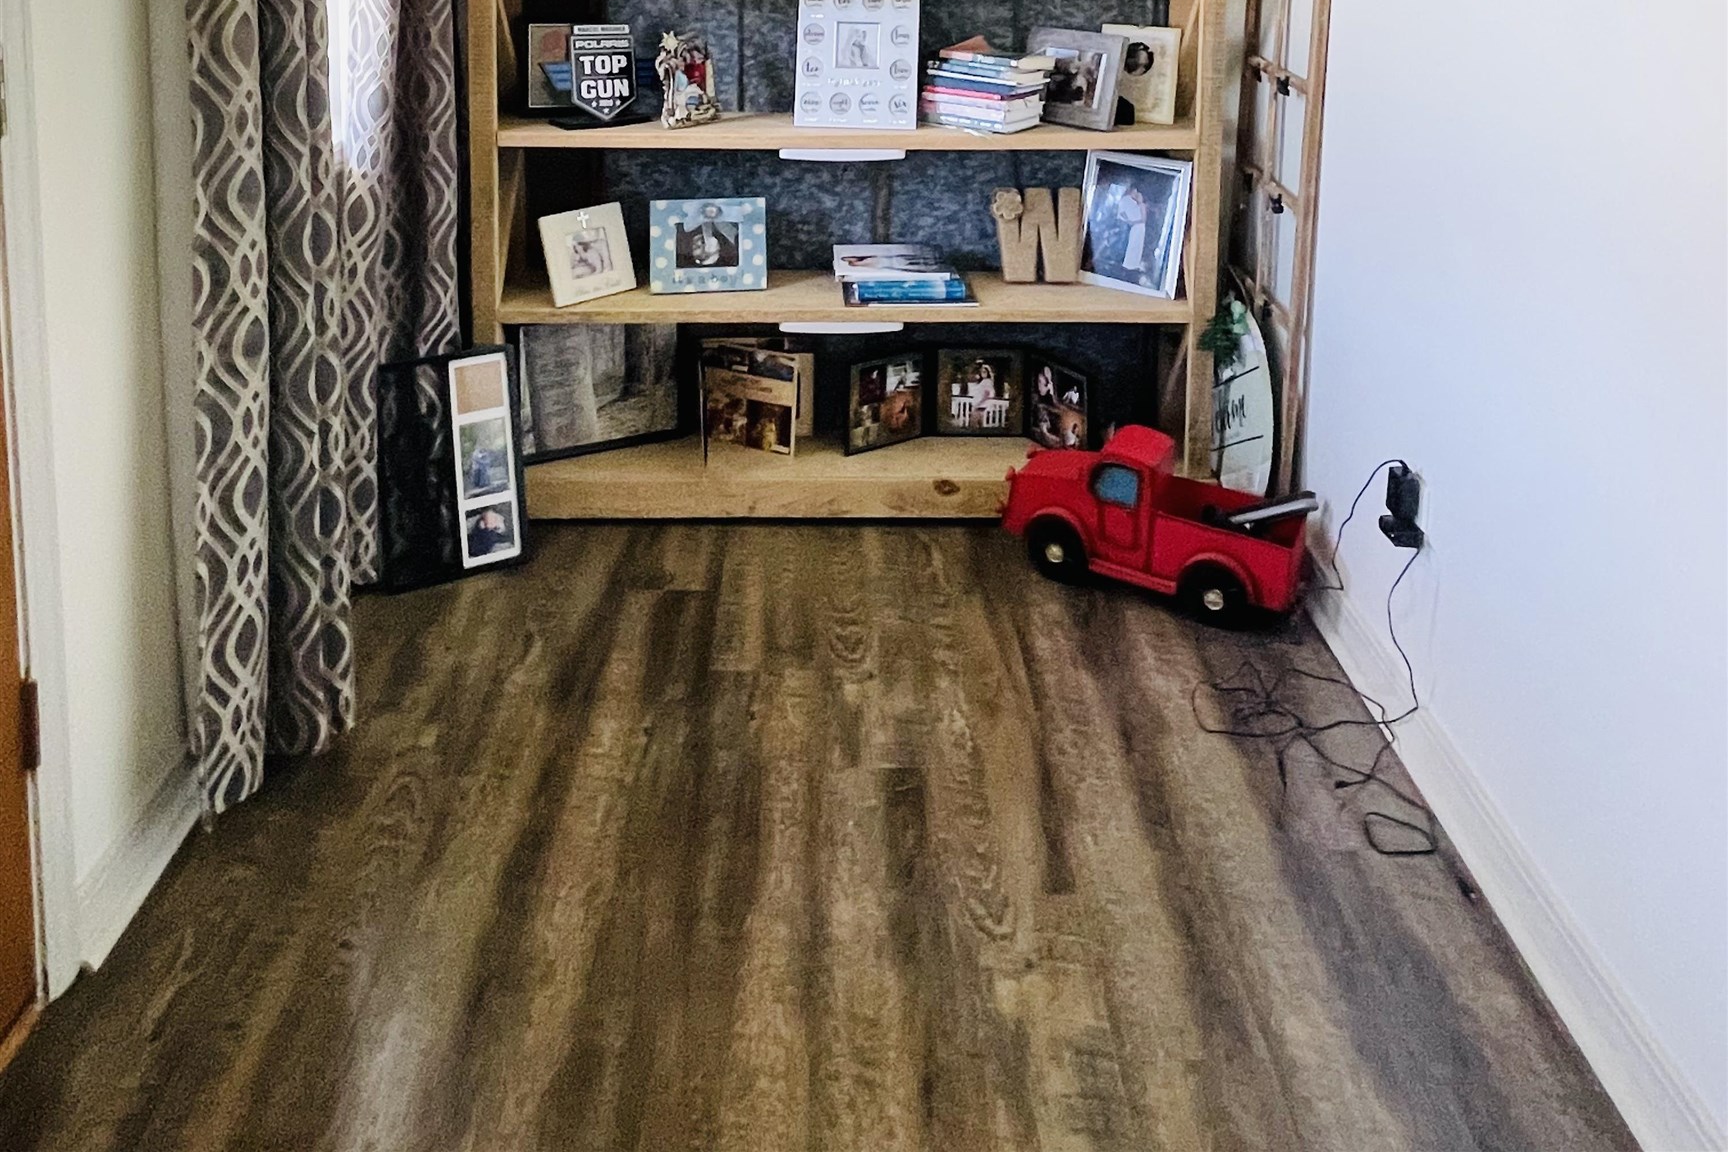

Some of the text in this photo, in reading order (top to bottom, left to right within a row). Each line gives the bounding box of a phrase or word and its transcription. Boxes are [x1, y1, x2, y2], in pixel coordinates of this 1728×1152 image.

[575, 39, 630, 49] POLARIS
[579, 55, 628, 75] TOP
[580, 79, 630, 99] GUN
